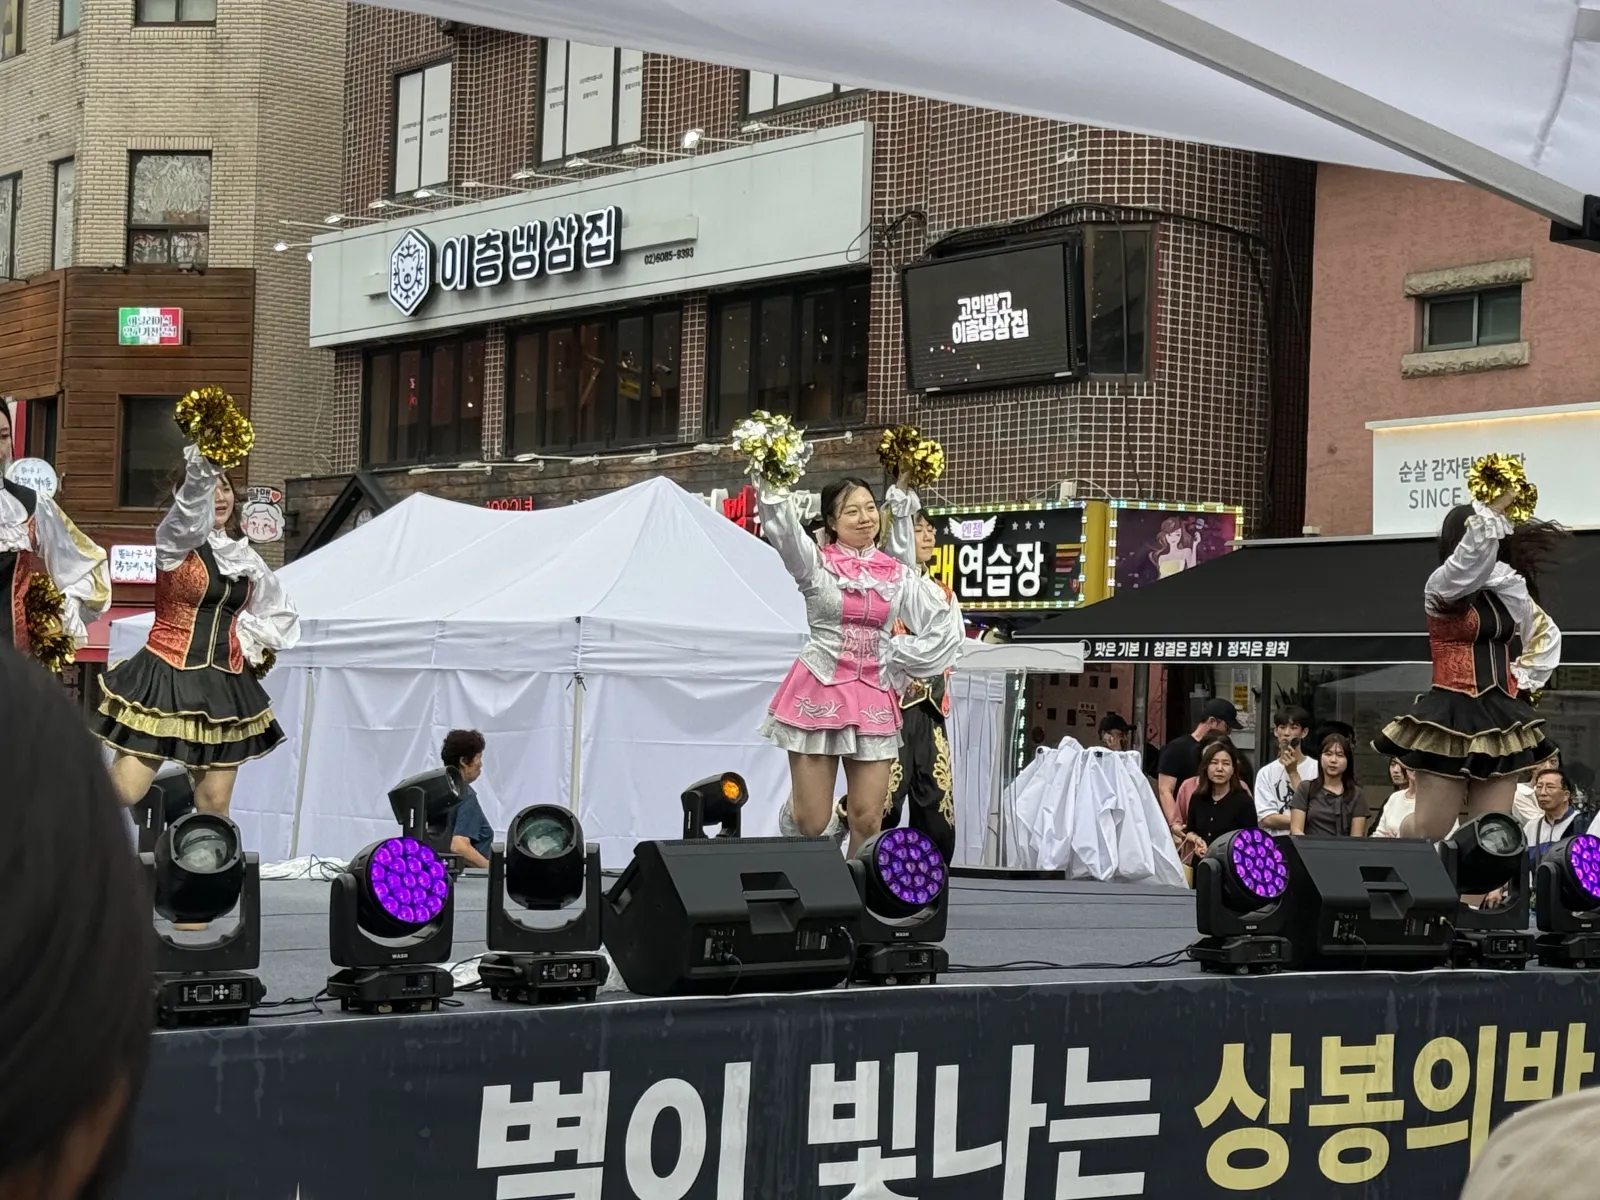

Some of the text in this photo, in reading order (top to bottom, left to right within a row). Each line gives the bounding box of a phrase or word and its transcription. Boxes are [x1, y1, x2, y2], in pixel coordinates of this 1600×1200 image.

[440, 205, 619, 291] 이층냉삼집
[957, 291, 1012, 321] 고민말고
[952, 308, 1029, 344] 이층냉삼집
[1399, 459, 1427, 483] 순살
[1408, 487, 1462, 510] SINCE
[961, 520, 983, 538] 엔젤
[929, 541, 1045, 598] 래연습장
[1094, 641, 1290, 658] 맛은 기본 청결은 집착 정직은 원칙
[477, 1061, 752, 1200] 별이
[807, 1044, 1161, 1200] 빛나는
